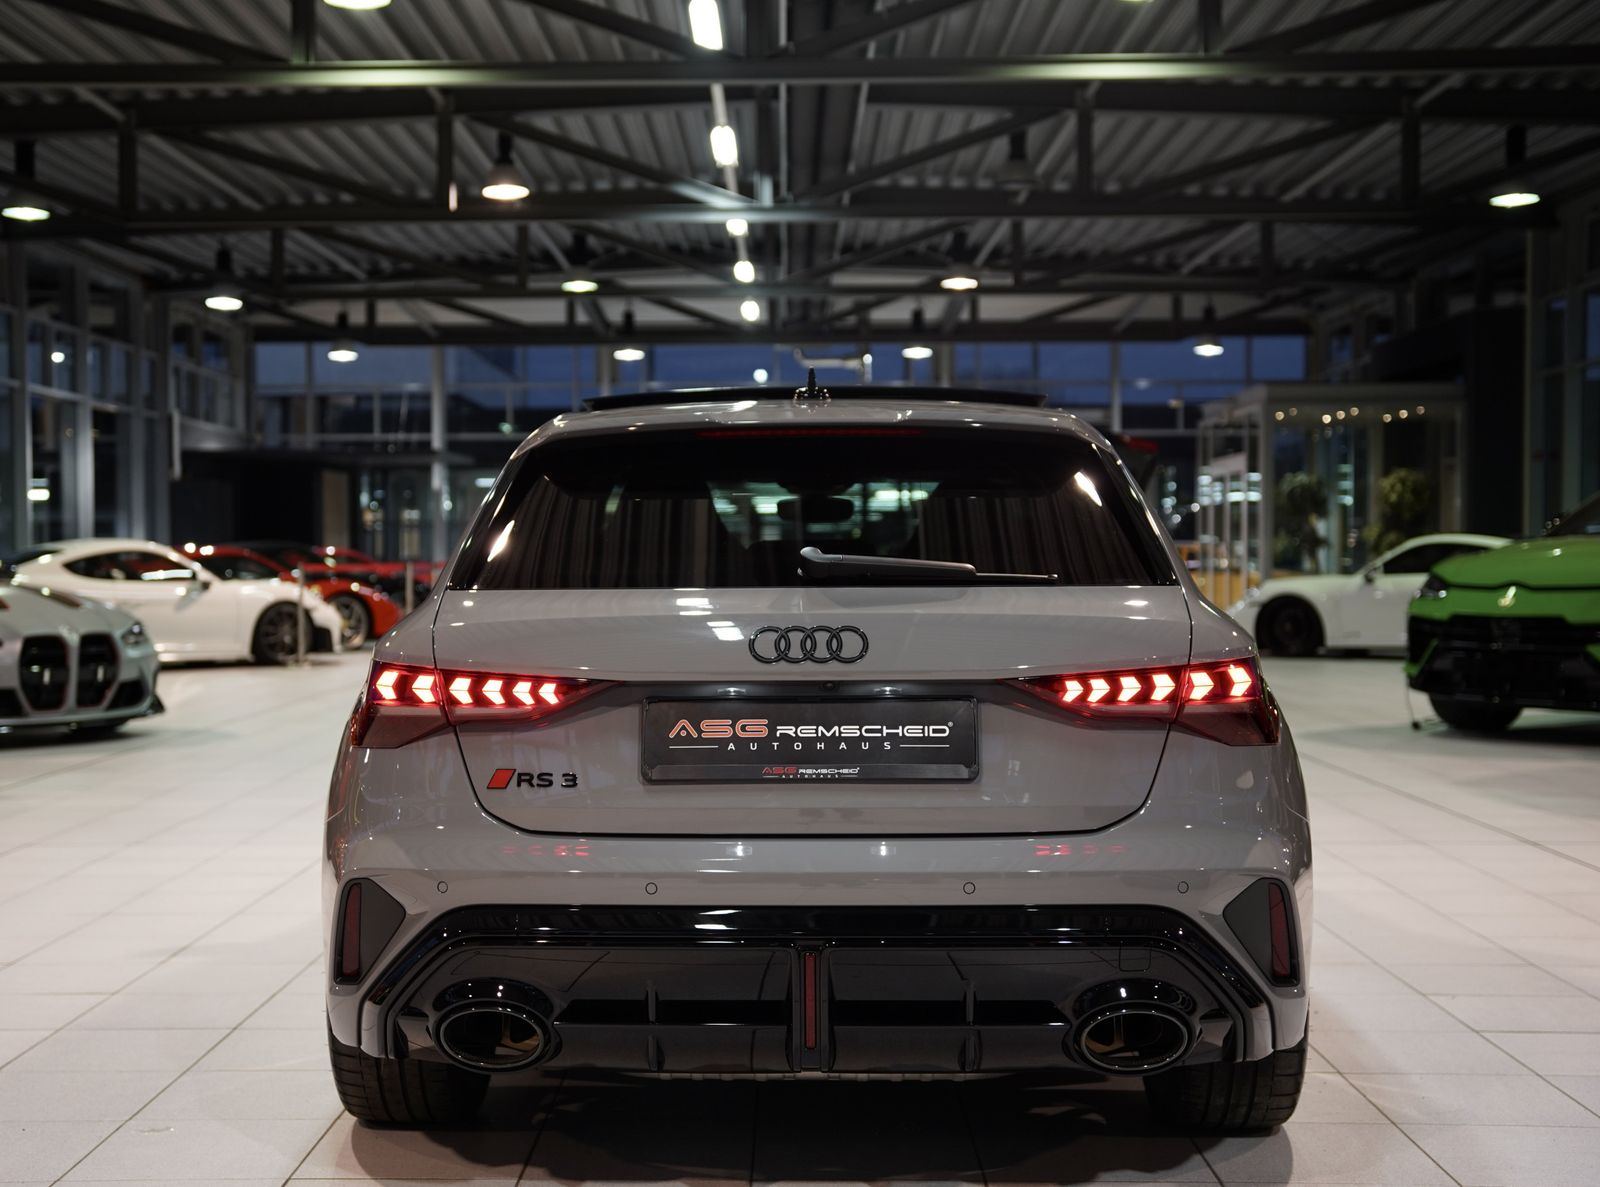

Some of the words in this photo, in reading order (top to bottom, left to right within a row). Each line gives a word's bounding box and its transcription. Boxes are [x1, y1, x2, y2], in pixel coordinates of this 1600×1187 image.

[668, 719, 769, 738] ASG
[728, 742, 892, 751] AUTOHAUS
[517, 772, 555, 788] RS
[560, 773, 578, 788] 3
